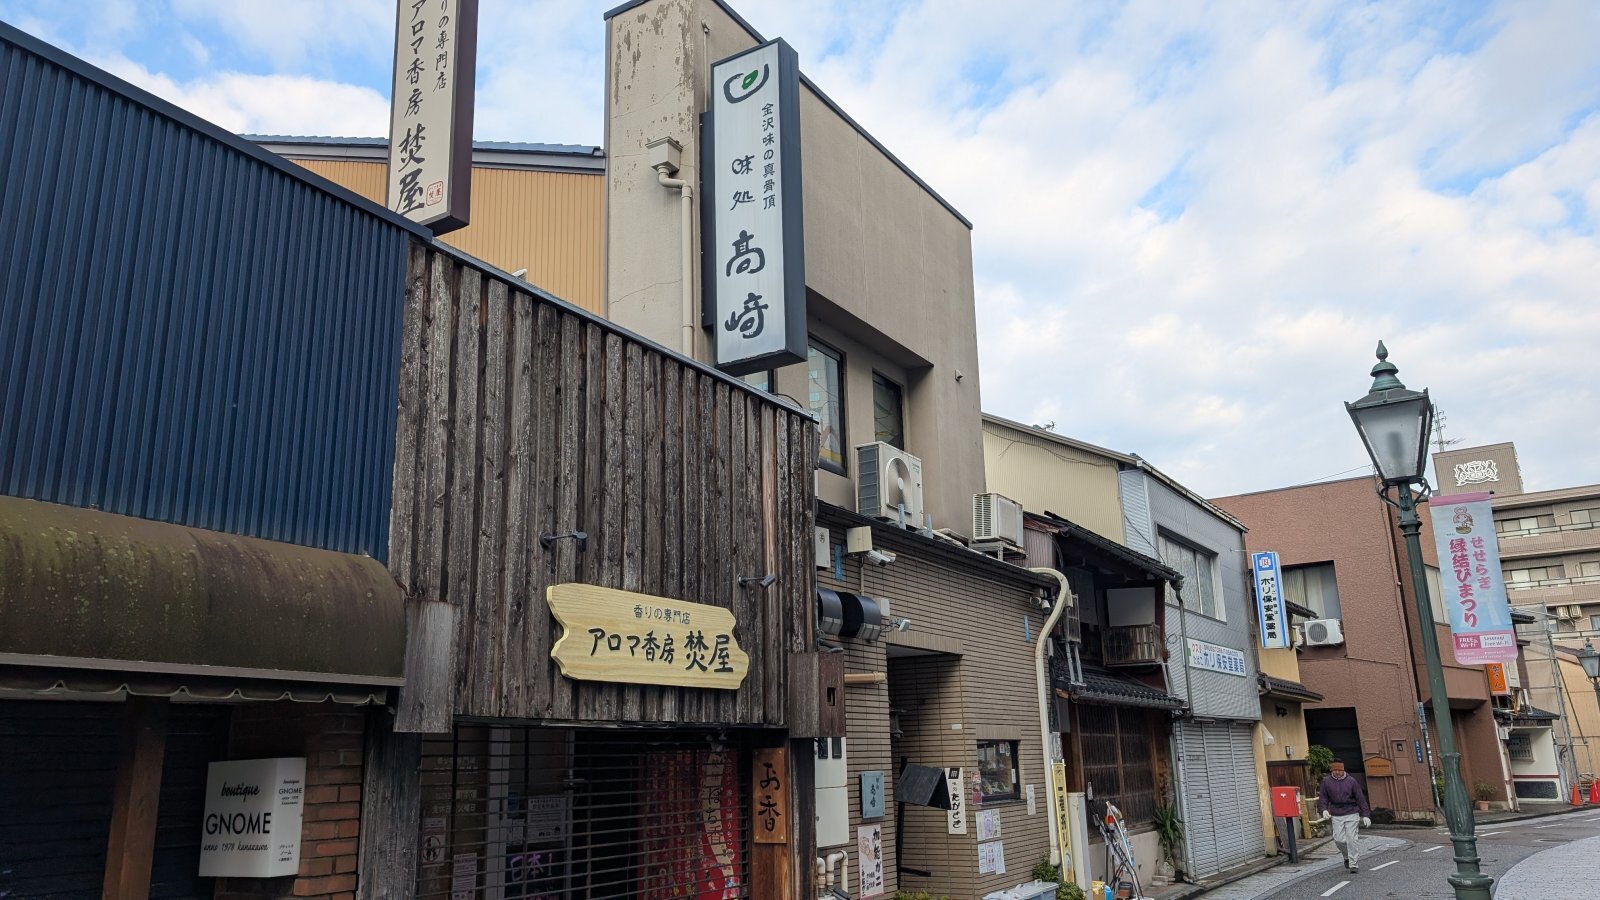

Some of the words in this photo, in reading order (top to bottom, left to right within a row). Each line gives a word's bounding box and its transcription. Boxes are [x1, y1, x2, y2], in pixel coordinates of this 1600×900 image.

[761, 103, 776, 210] 金沢味の真骨頂
[1449, 538, 1478, 628] 縁結びまつり
[1470, 536, 1491, 590] せせらぎ
[633, 604, 691, 625] 香りの専門店
[587, 627, 675, 665] アロマ香房
[684, 629, 734, 673] 焚屋
[220, 780, 260, 802] boutique
[758, 762, 781, 832] お香
[205, 812, 271, 835] GNOME
